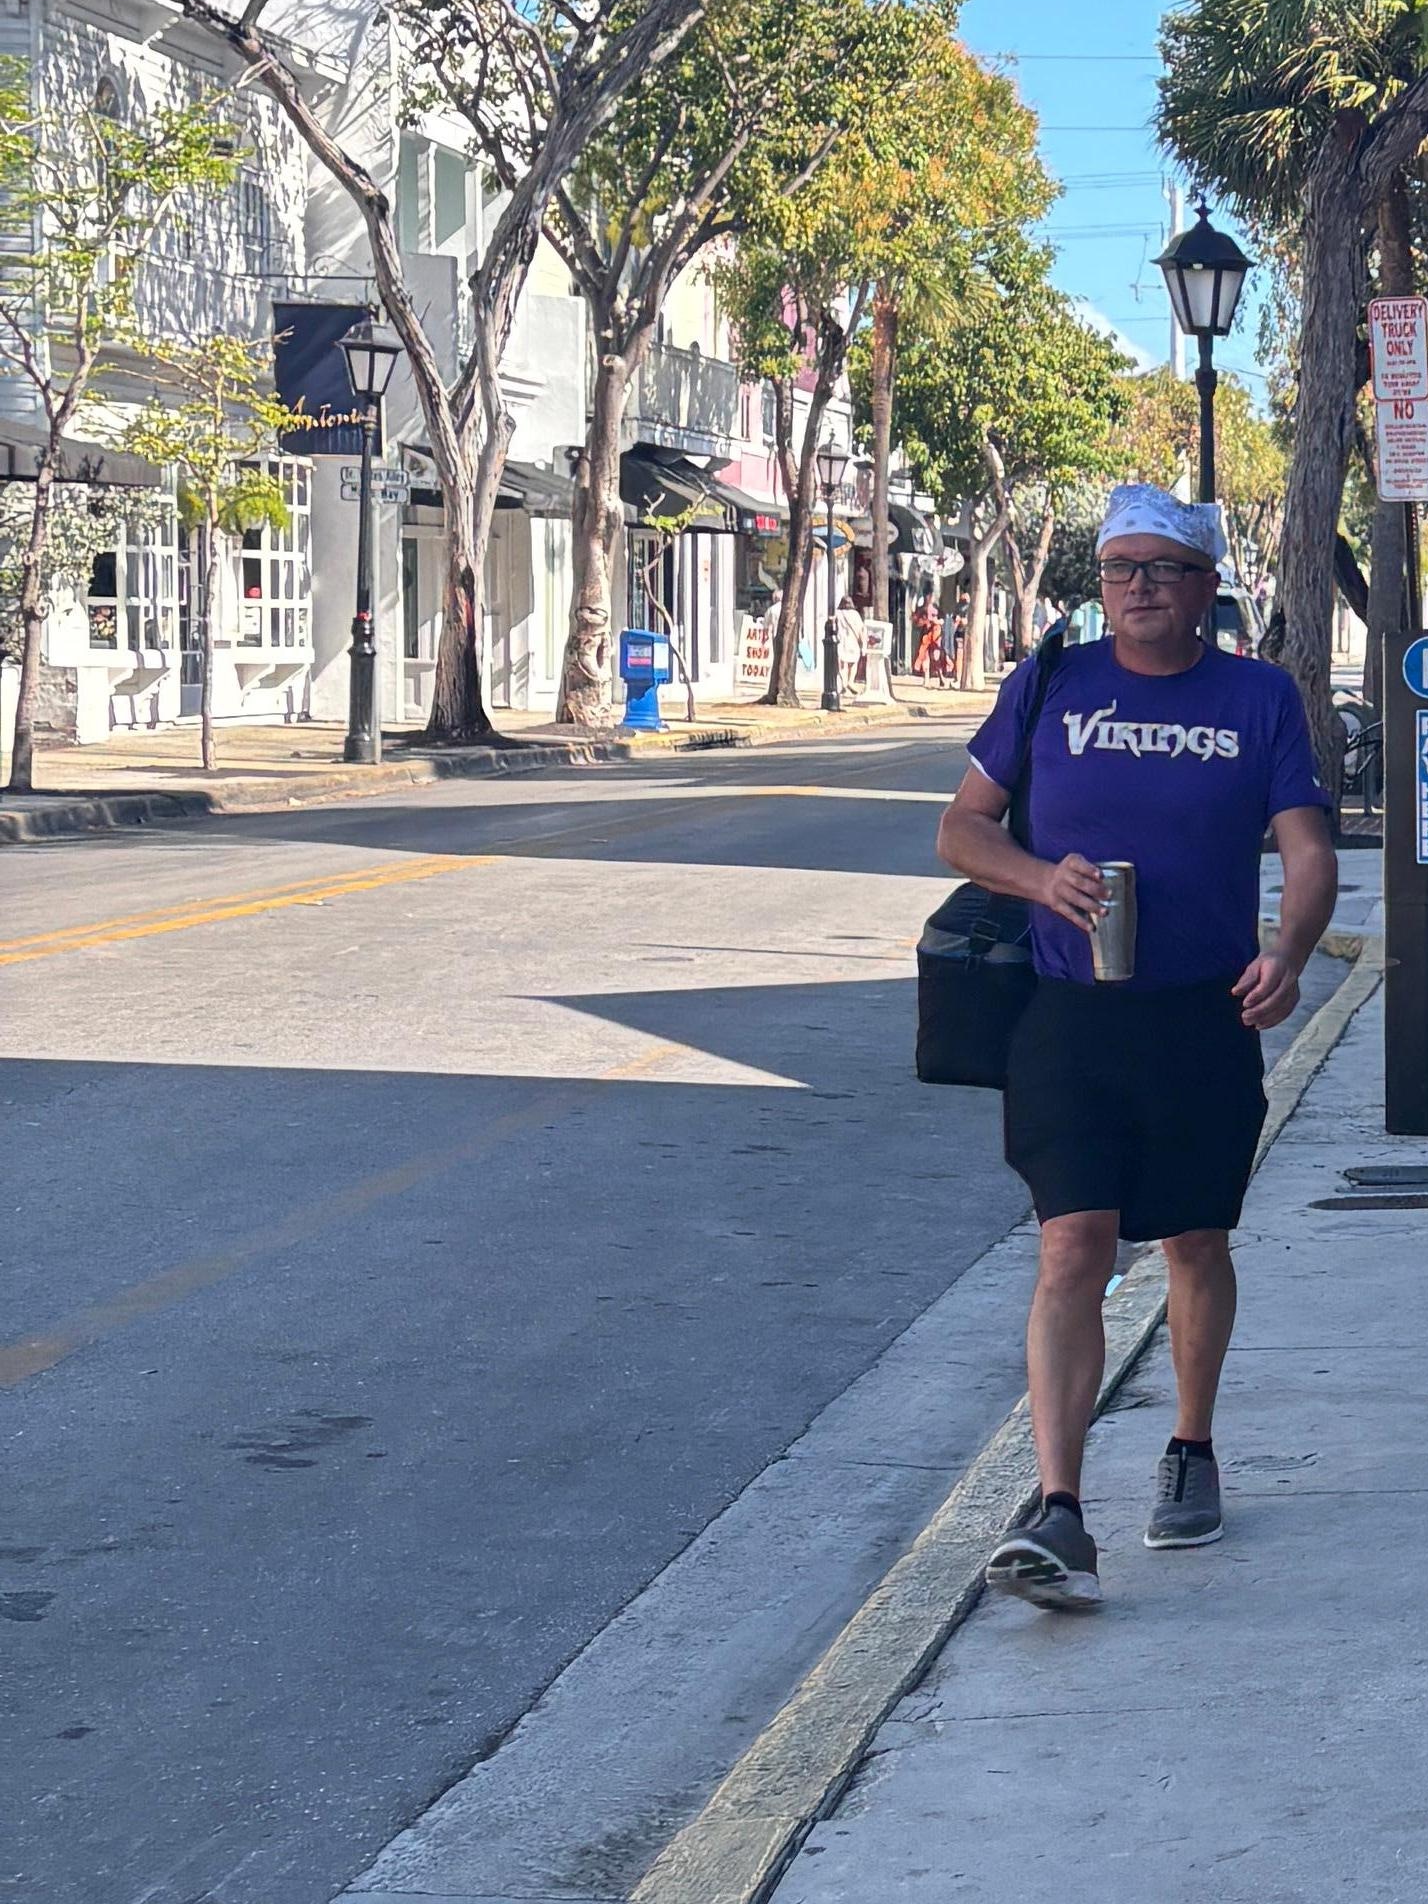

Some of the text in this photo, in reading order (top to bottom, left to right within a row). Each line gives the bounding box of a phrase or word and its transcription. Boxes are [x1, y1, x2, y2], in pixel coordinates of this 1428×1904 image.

[1373, 302, 1423, 321] DELIVERY
[1381, 321, 1418, 338] TRUCK
[1386, 339, 1414, 356] ONLY
[1393, 398, 1415, 420] NO
